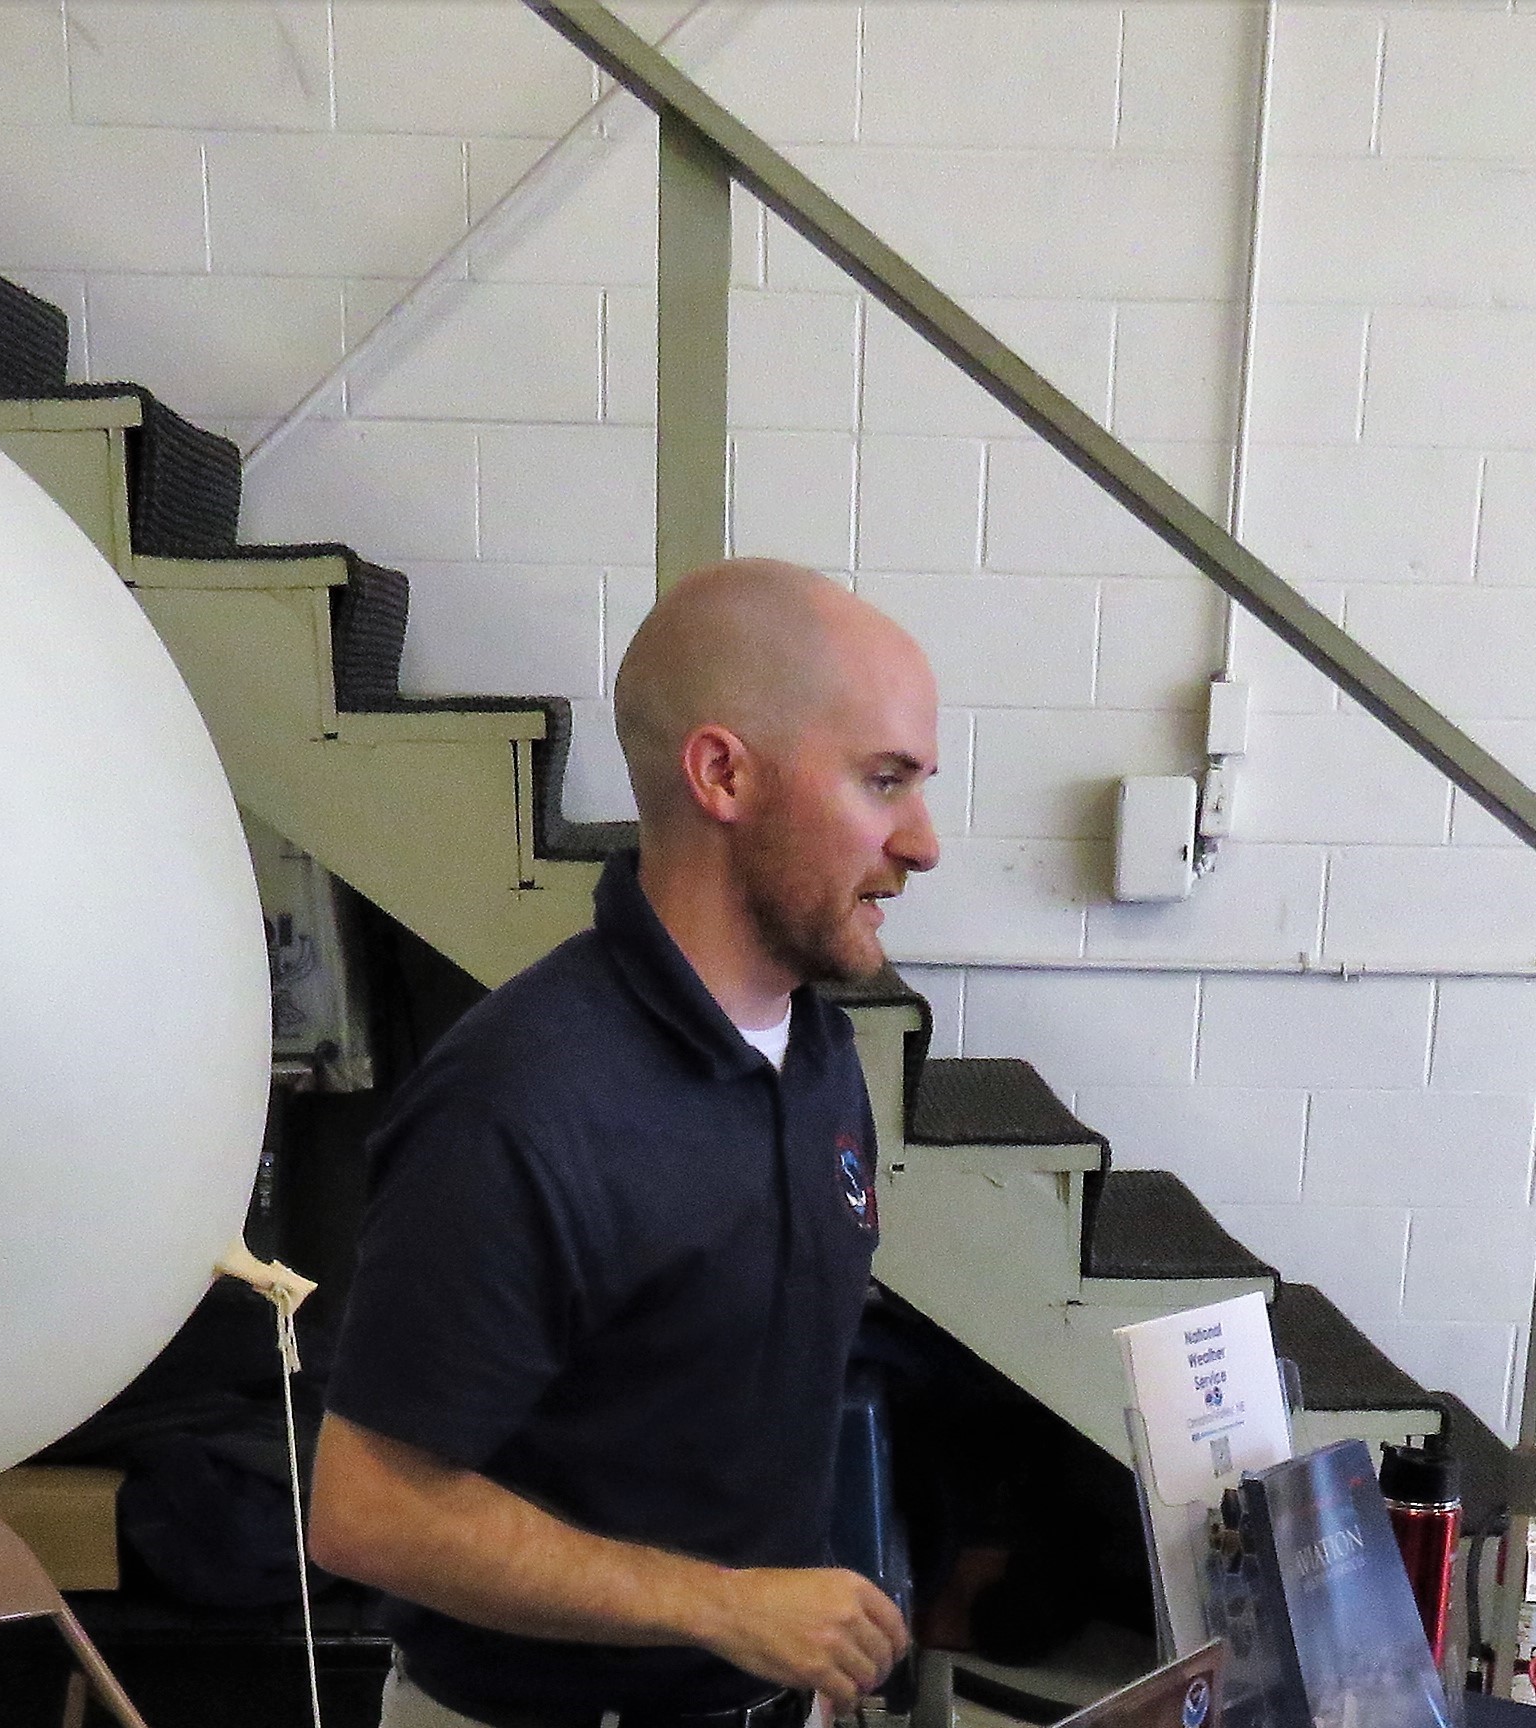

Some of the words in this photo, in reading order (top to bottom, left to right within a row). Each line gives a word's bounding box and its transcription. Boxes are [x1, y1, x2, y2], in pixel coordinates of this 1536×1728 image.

[1184, 1322, 1222, 1345] National
[1188, 1347, 1226, 1368] Weather
[1194, 1369, 1227, 1391] Service
